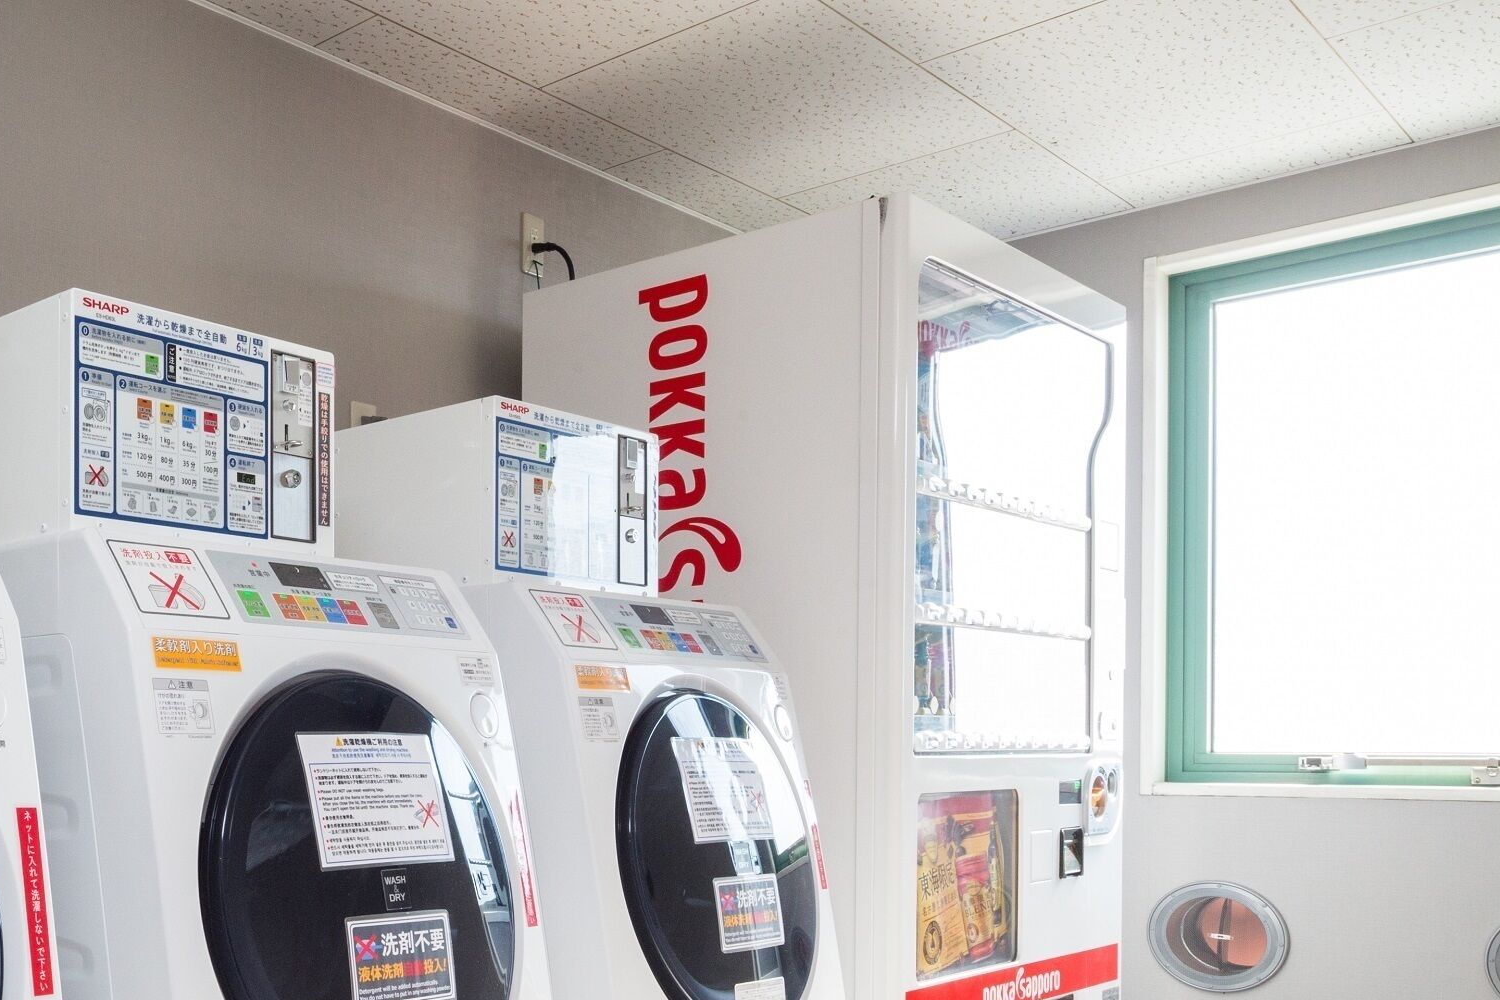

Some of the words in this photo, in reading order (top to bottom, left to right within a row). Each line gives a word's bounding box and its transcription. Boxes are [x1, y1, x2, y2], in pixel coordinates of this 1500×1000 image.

[83, 297, 130, 316] SHARP
[136, 312, 227, 345] 洗濯から乾燥まで全自動
[500, 401, 530, 415] SHARP
[155, 639, 237, 657] 柔軟剤入り洗剤
[178, 681, 194, 690] 注意
[343, 738, 403, 747] 洗濯乾燥機ご利用の注意
[384, 875, 407, 885] WASH
[24, 811, 48, 992] ネットに入れて洗濯しないで下さい
[389, 893, 406, 903] DRY
[736, 889, 776, 909] 洗剤不要
[381, 927, 445, 957] 洗剤不要
